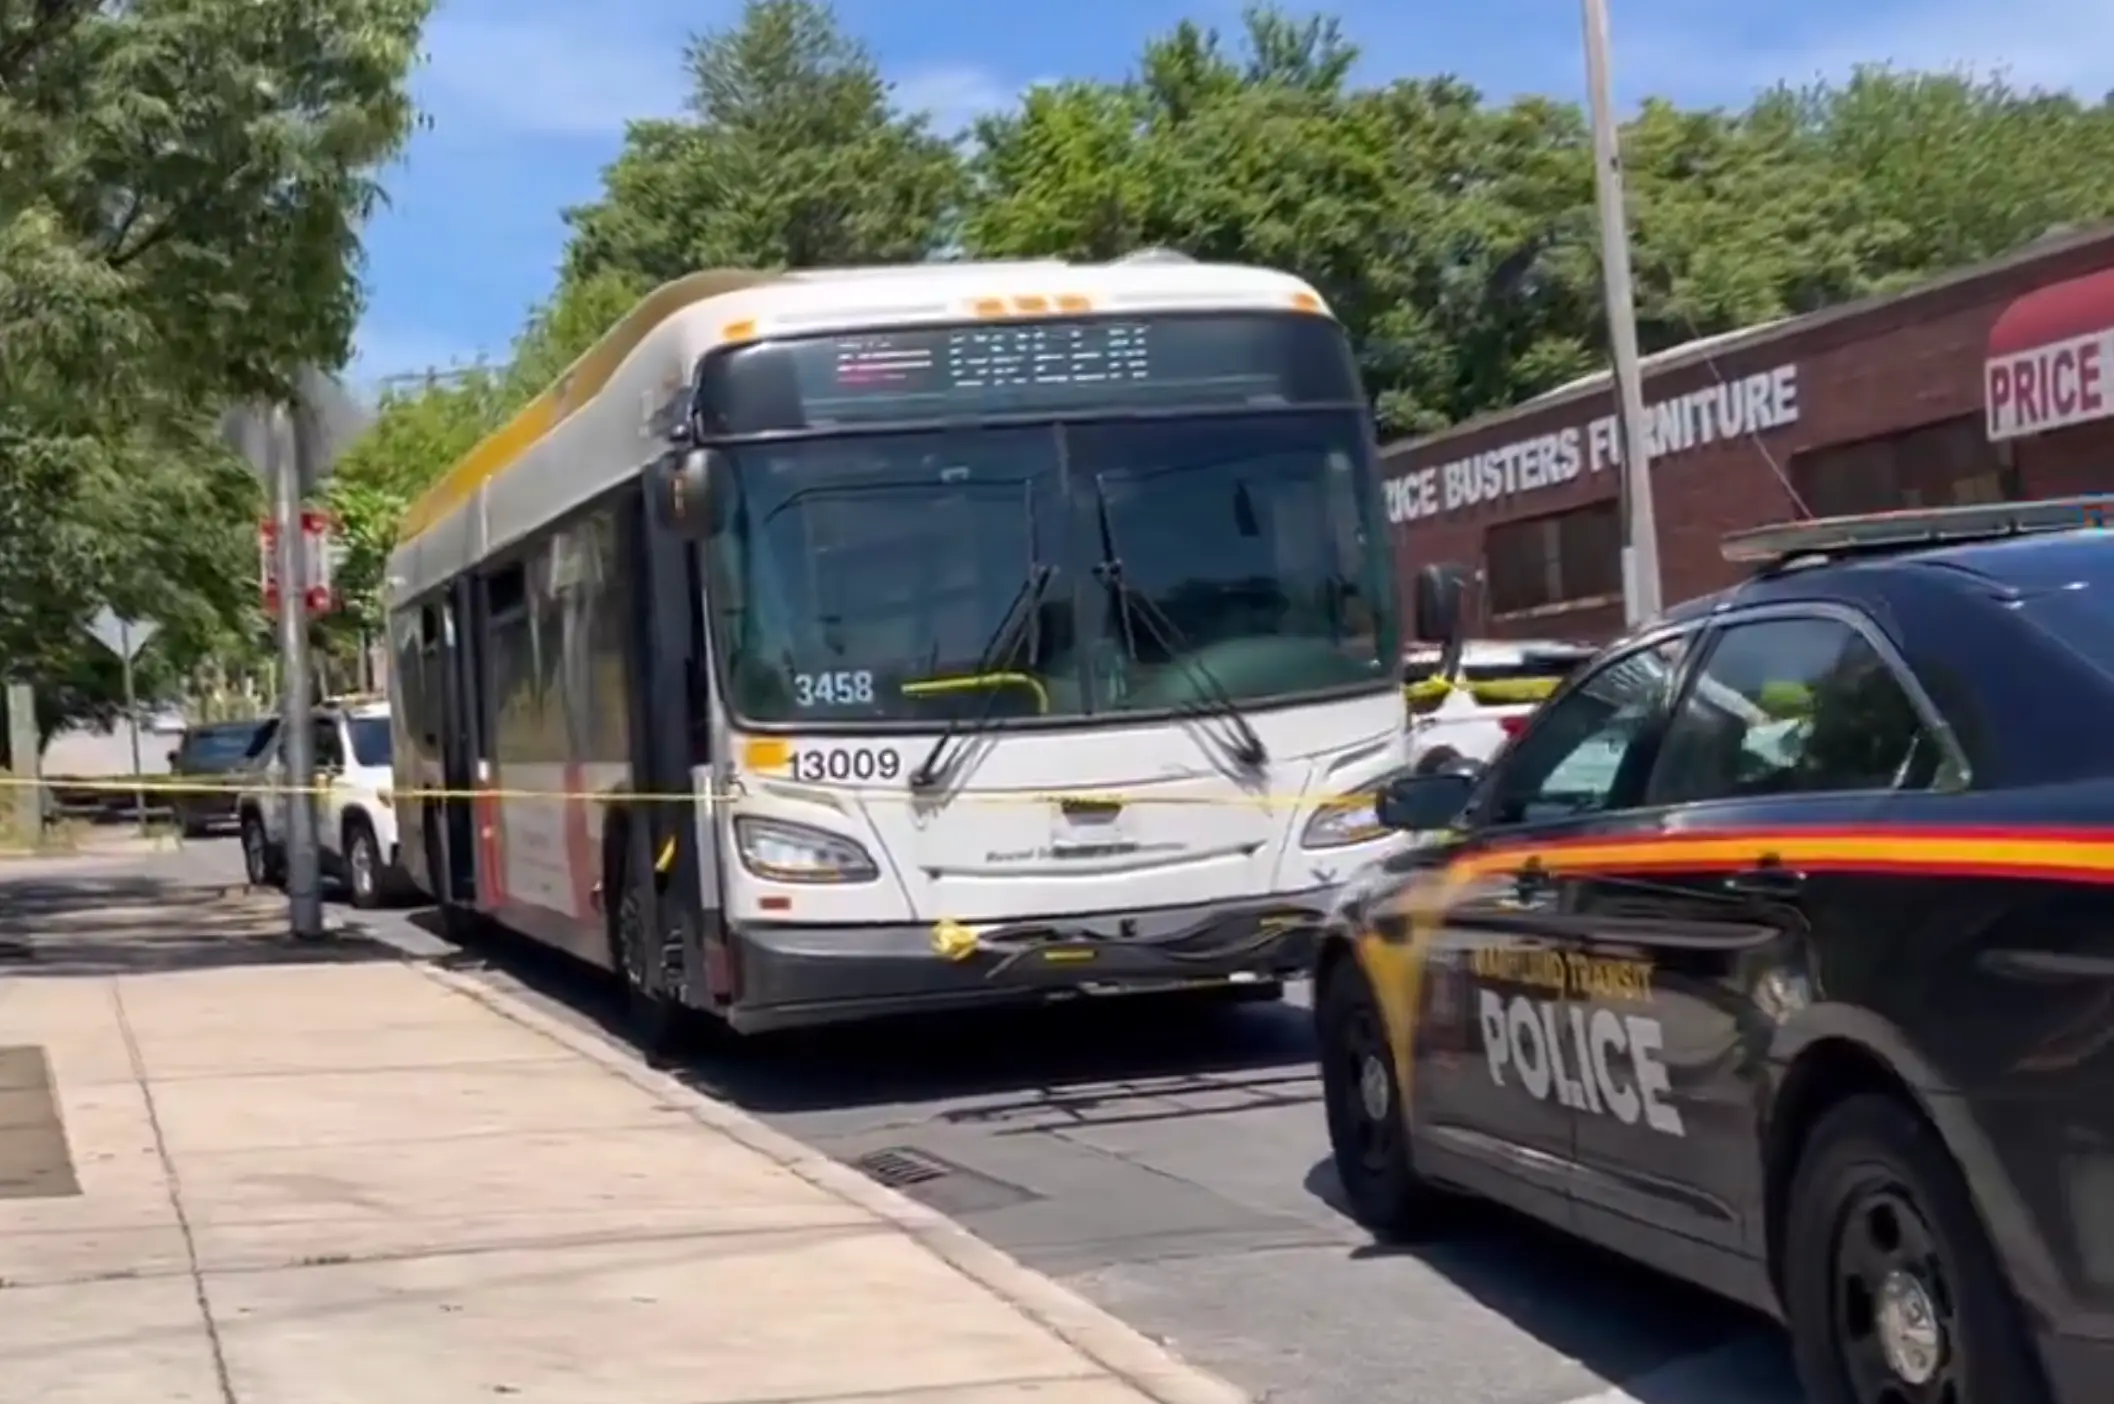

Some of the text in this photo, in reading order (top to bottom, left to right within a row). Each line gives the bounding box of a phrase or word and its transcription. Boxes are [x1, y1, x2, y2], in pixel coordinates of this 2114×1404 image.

[1990, 342, 2102, 432] PRICE
[1442, 428, 1581, 509] BUSTERS
[794, 669, 874, 707] 3458
[785, 747, 900, 782] 13009
[1480, 988, 1685, 1137] POLICE
